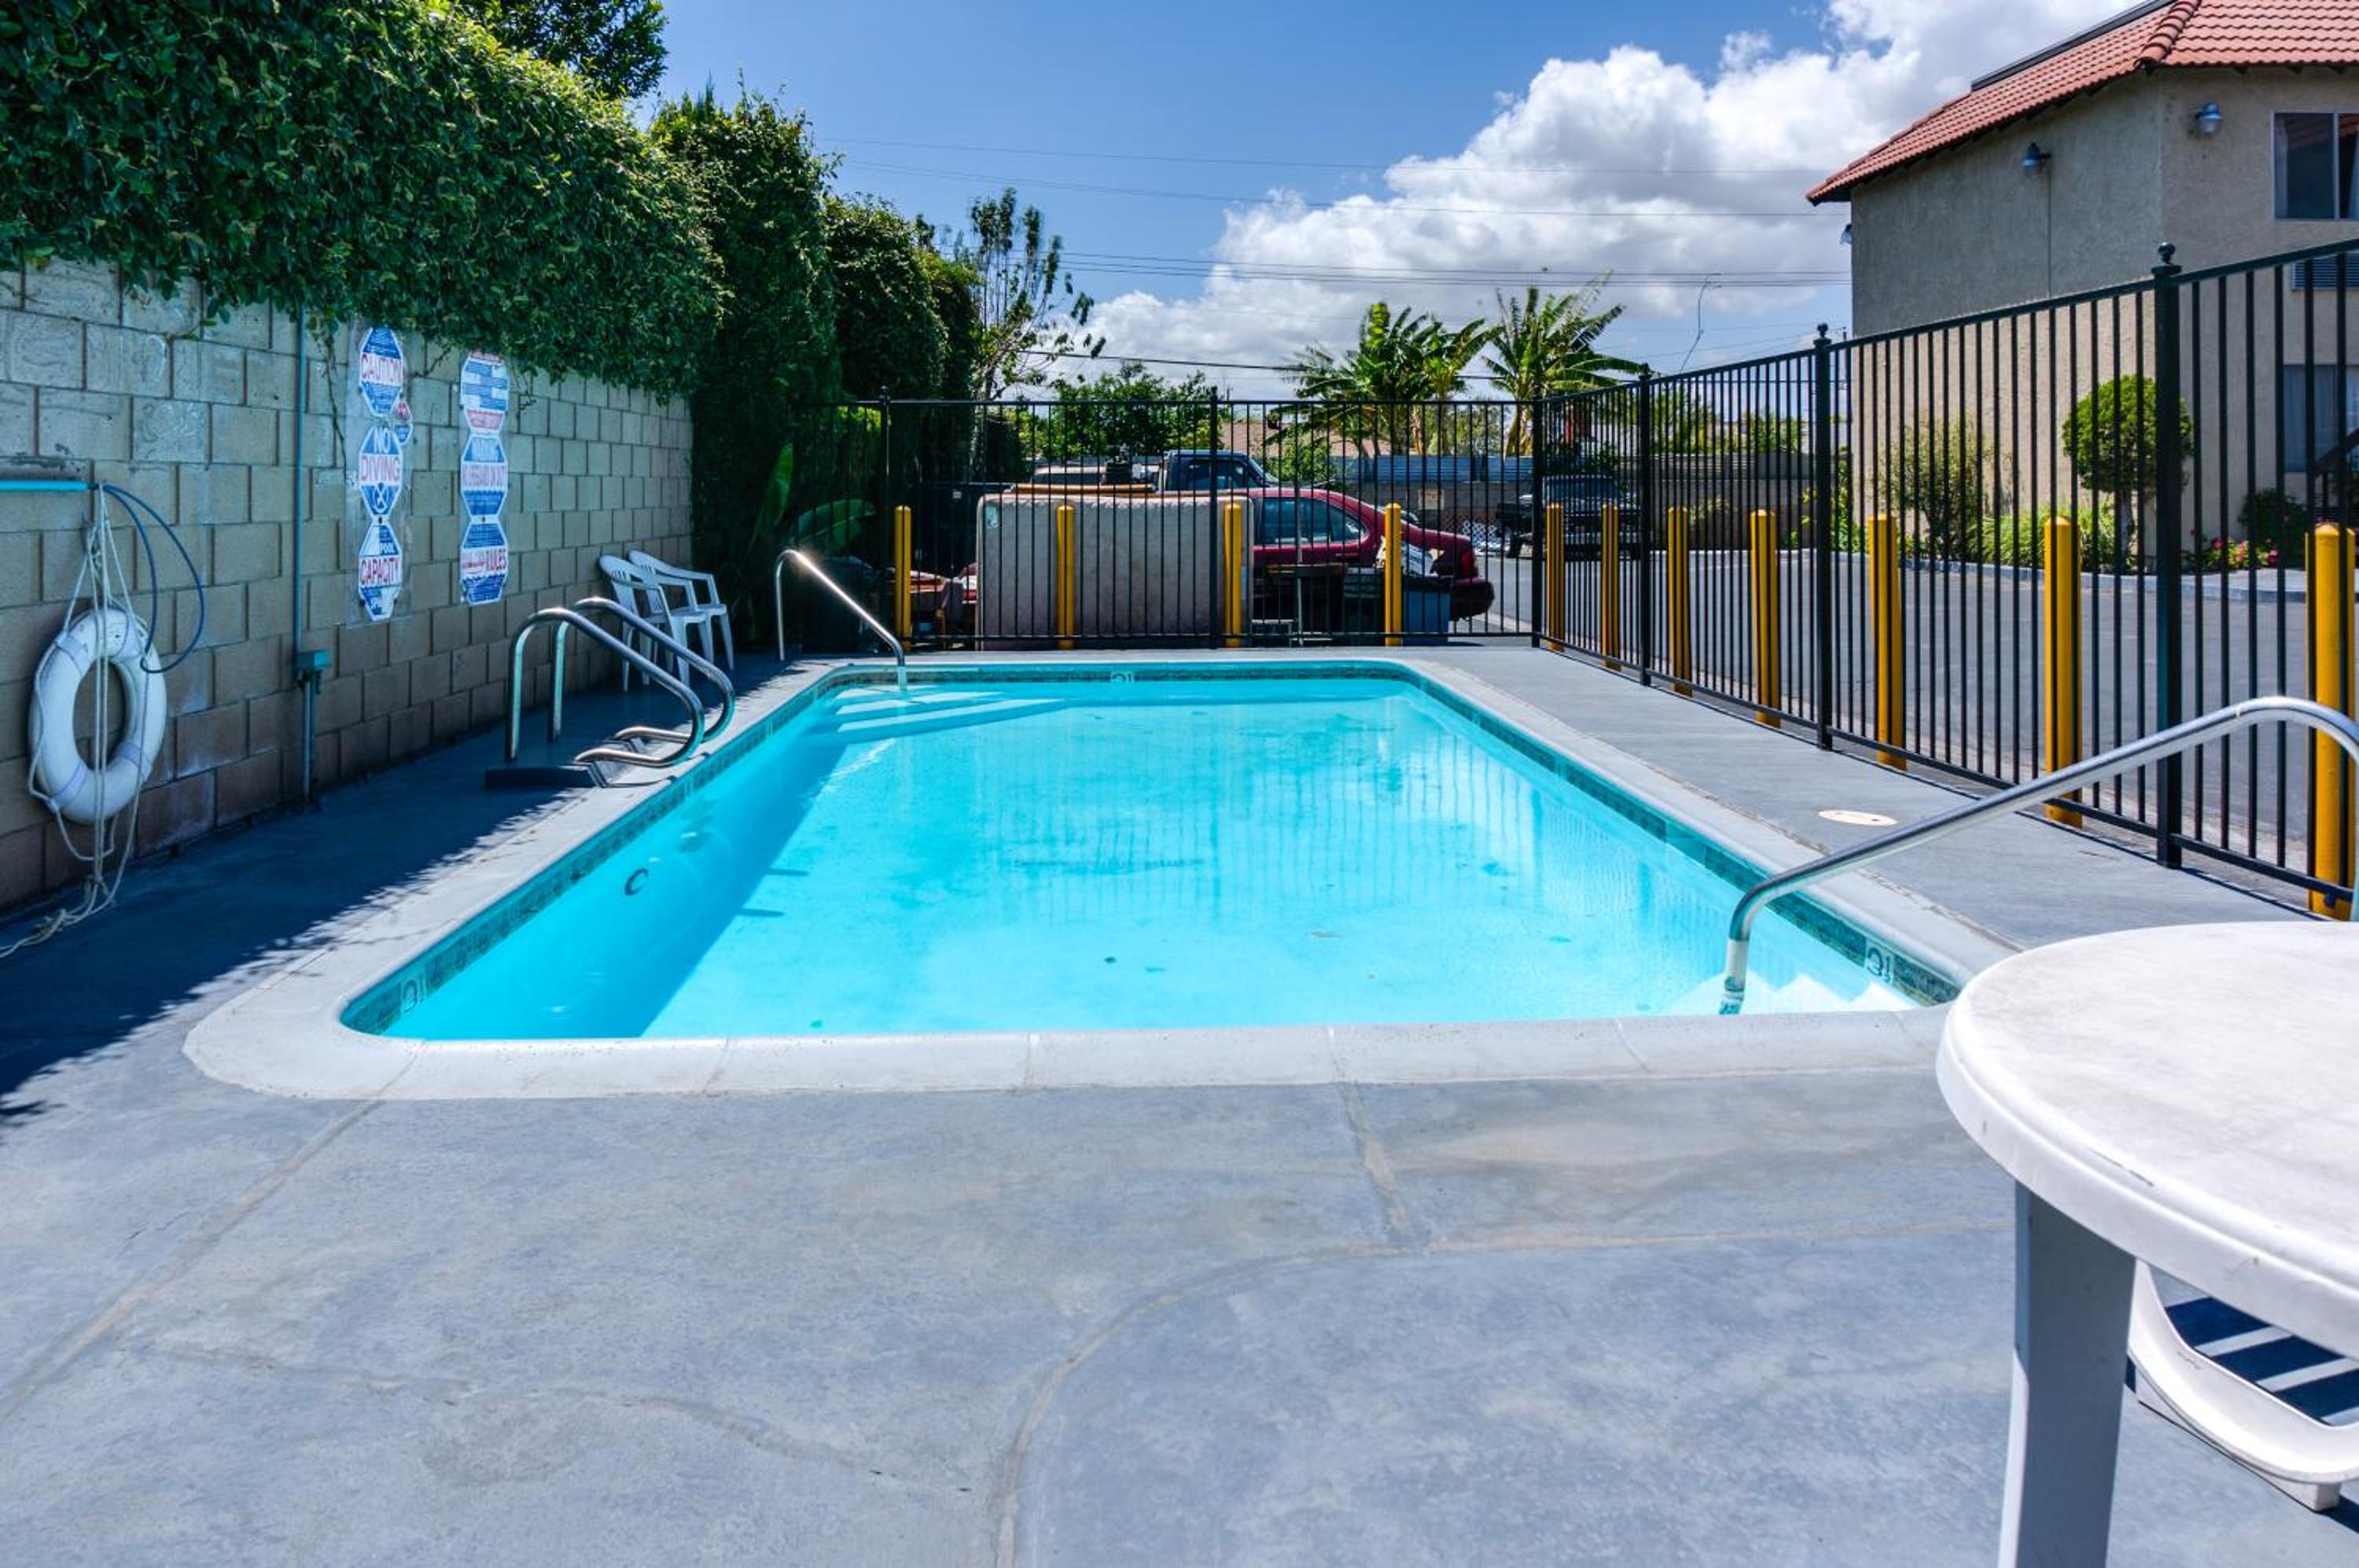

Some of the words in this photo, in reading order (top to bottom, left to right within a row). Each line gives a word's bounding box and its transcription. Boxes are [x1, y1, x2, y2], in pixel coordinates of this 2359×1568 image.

[361, 353, 402, 385] CAUTION
[374, 427, 390, 454] NO
[362, 455, 400, 482] DIVING
[361, 556, 402, 586] CAPACITY
